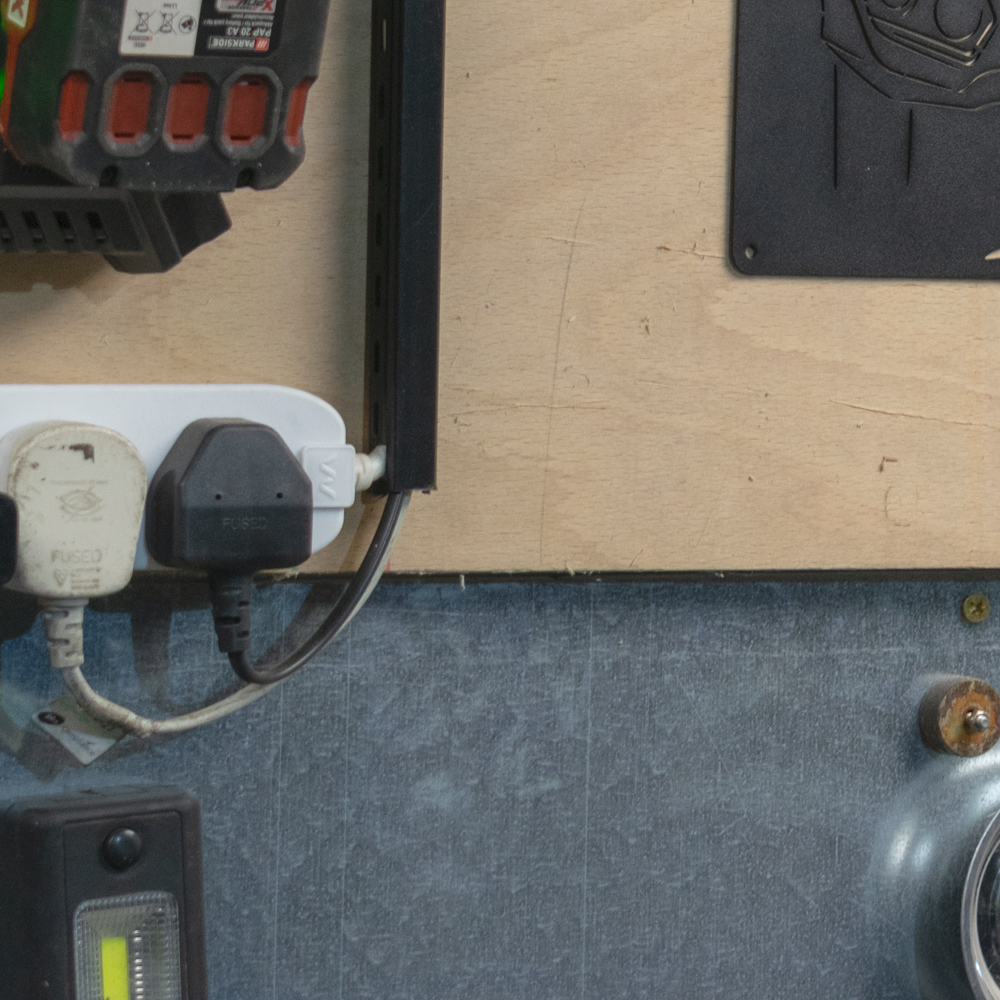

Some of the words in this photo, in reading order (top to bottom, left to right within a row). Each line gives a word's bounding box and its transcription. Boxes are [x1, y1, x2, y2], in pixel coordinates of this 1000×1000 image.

[227, 27, 239, 36] A3
[241, 27, 252, 36] 20
[253, 27, 272, 37] PAP
[212, 37, 256, 48] PARKSIDE
[51, 550, 103, 563] FUSED
